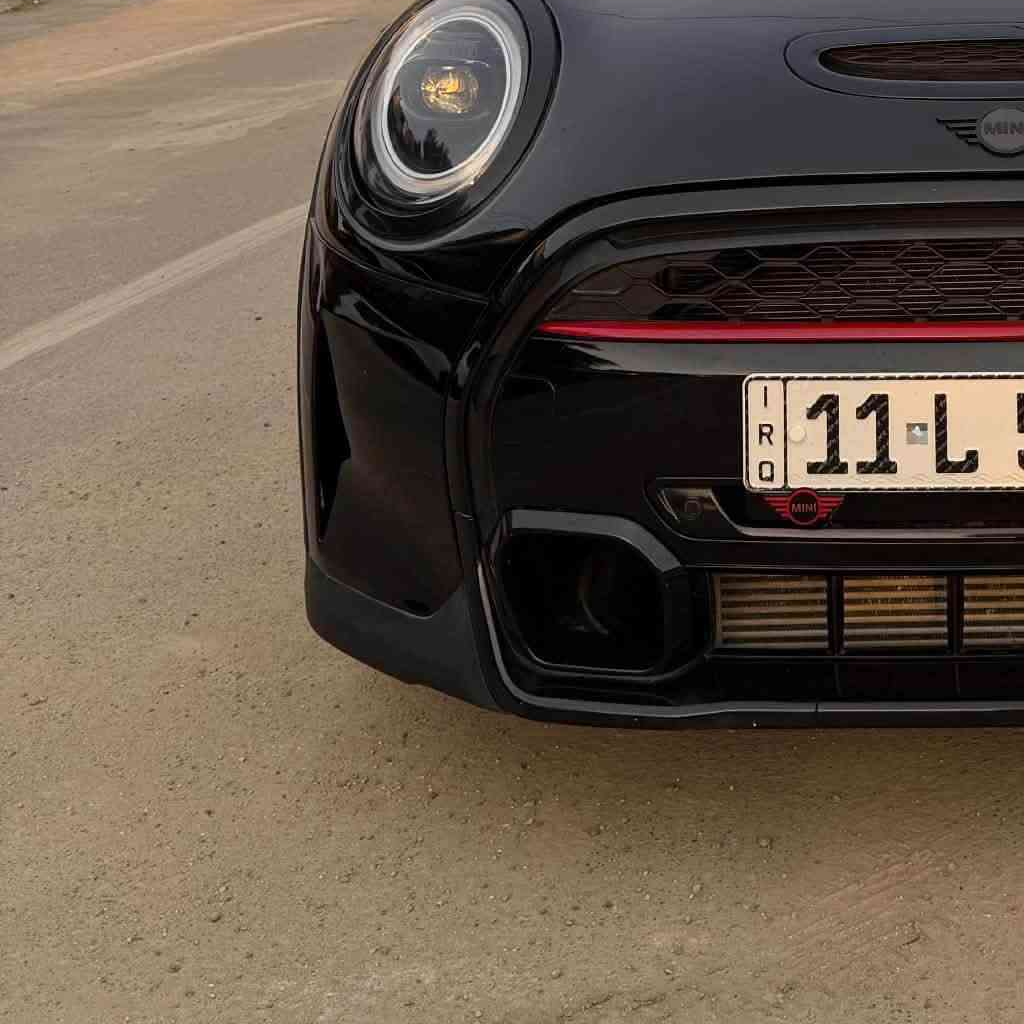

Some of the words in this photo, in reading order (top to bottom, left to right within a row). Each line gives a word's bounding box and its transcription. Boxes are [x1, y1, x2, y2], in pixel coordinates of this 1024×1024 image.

[758, 386, 775, 482] IRQ
[806, 393, 898, 475] 11
[934, 393, 980, 474] L
[791, 502, 817, 514] MINI
